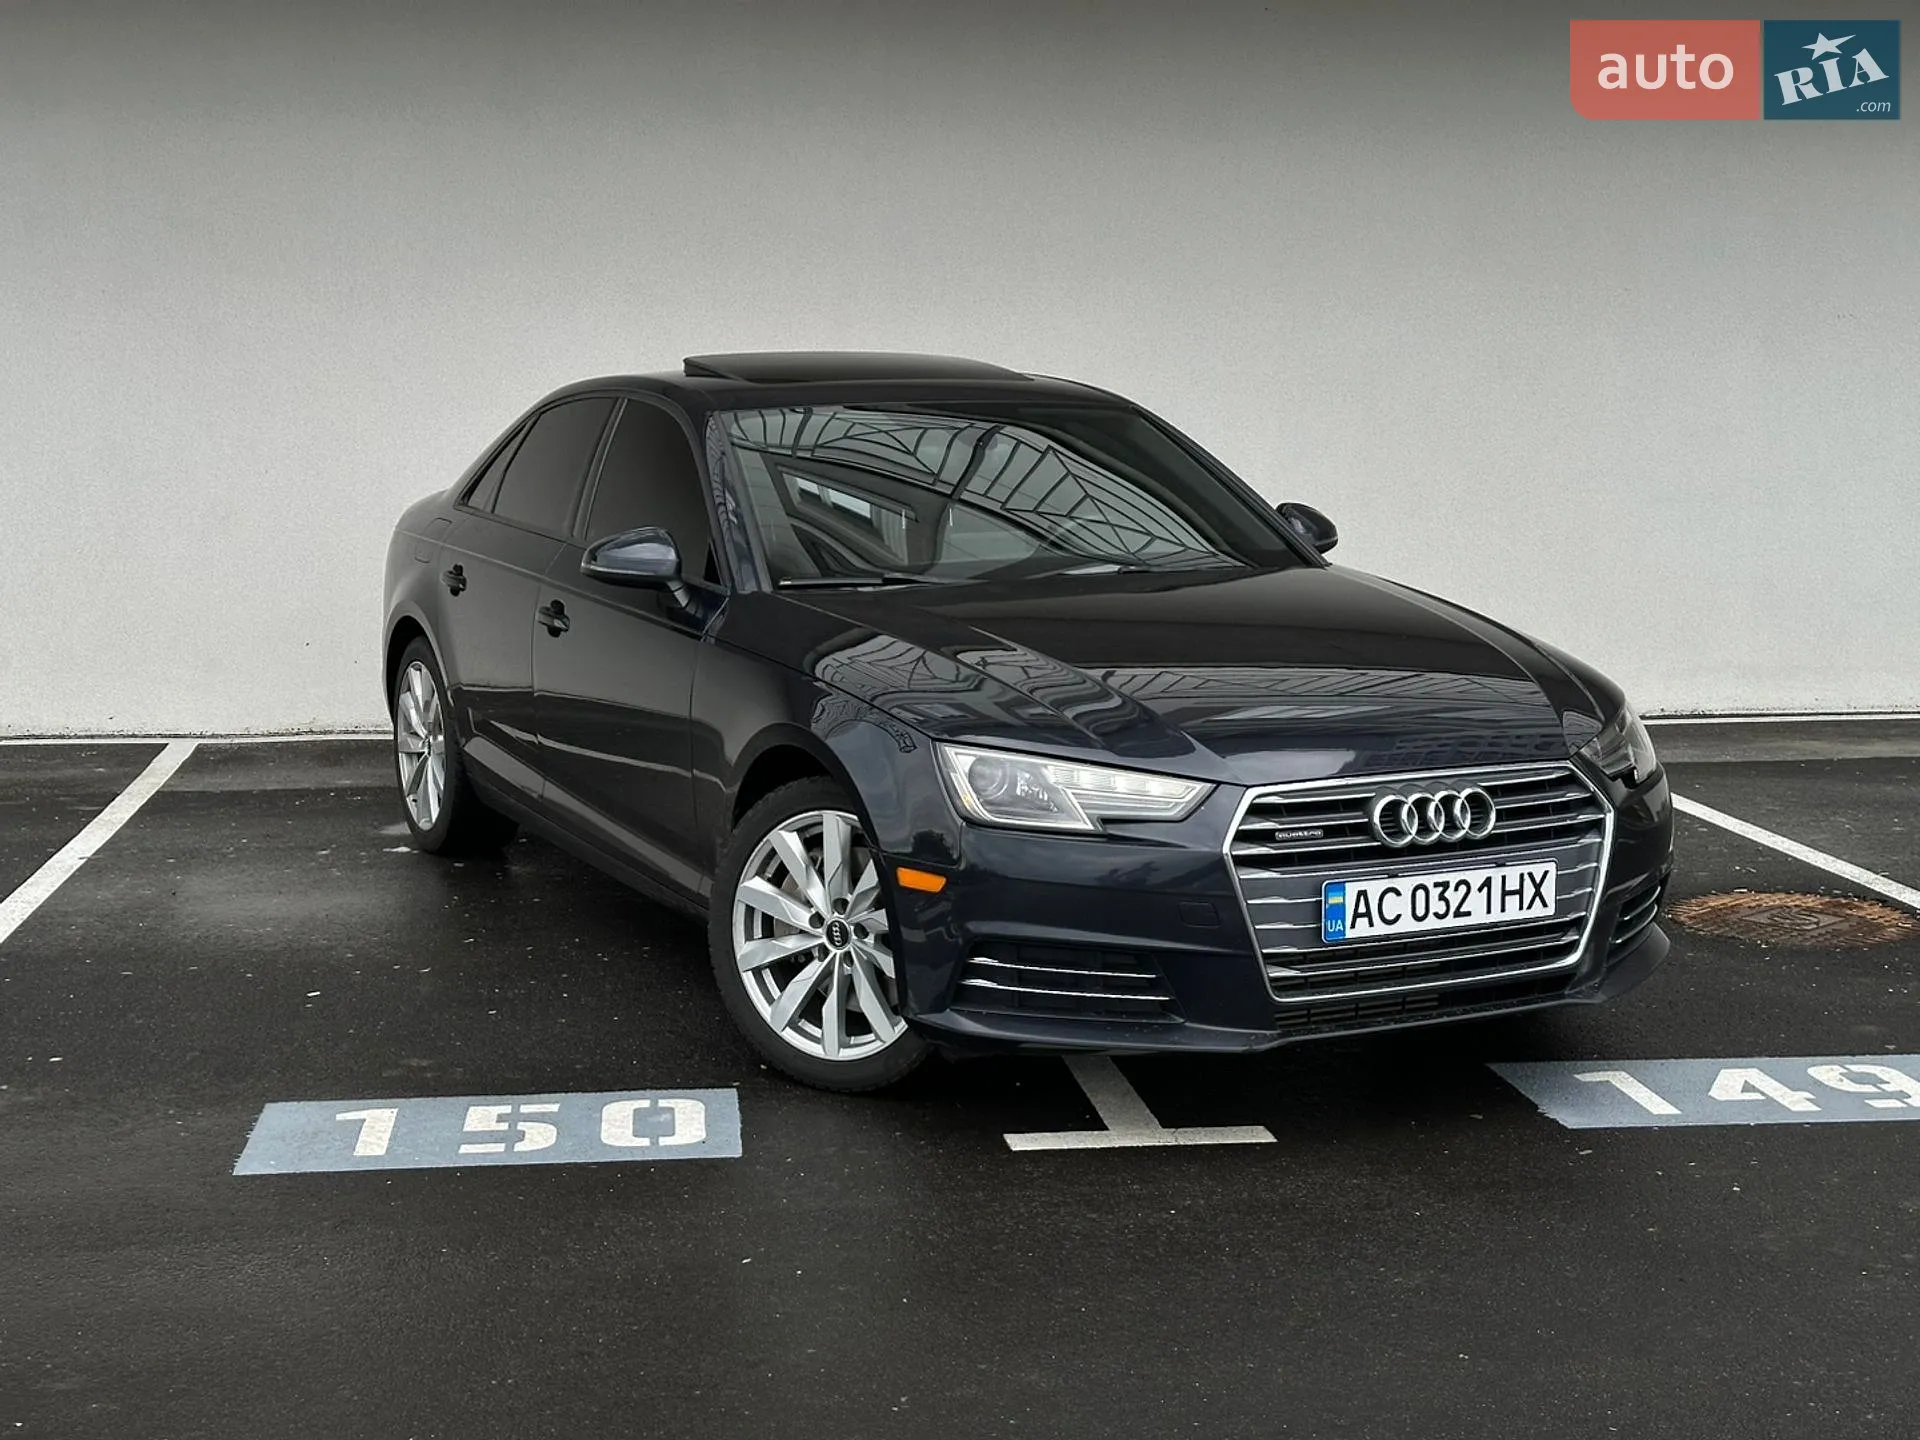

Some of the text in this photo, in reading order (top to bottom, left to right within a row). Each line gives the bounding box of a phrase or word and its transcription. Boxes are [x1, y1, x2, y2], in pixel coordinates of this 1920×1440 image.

[1327, 919, 1344, 932] UA
[1573, 1064, 1920, 1115] 149
[335, 1098, 707, 1156] 150
